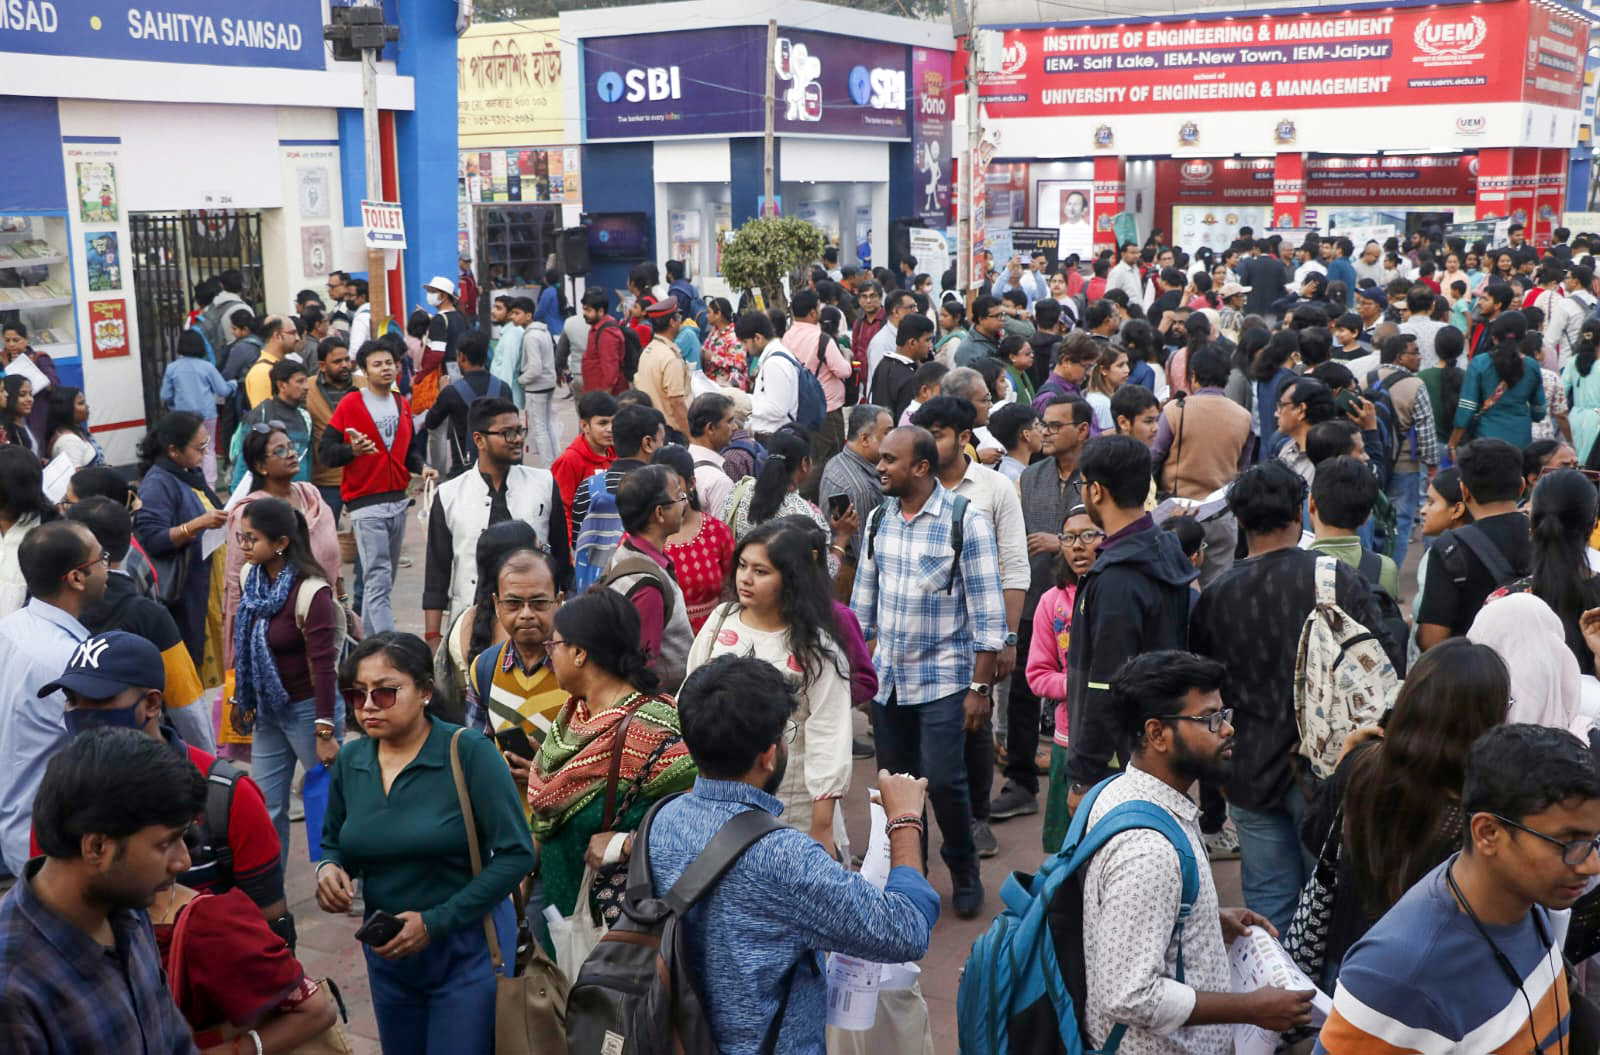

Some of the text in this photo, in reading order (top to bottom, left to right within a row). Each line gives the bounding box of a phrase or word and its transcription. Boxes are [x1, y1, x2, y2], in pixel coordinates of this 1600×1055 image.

[127, 9, 301, 52] SAHITYA SAMSAD
[1043, 16, 1394, 52] INSTITUTE OF ENGINEERING & MANAGEMENT
[1425, 22, 1474, 42] UEM
[1046, 43, 1389, 72] IEM- Salt Lake, IEM-New Town, IEM-Jaipur
[625, 65, 682, 103] SBI
[870, 66, 906, 110] SBI
[1042, 76, 1392, 105] UNIVERSITY OF ENGINEERING & MANAGEMENT
[1409, 77, 1485, 87] www.uem.edu.in
[1460, 118, 1481, 127] UEM
[1381, 157, 1460, 168] MANAGEMENT
[1378, 187, 1458, 197] MANAGEMENT
[364, 208, 401, 230] TOILET
[1037, 239, 1058, 248] LAW
[71, 638, 109, 669] NY
